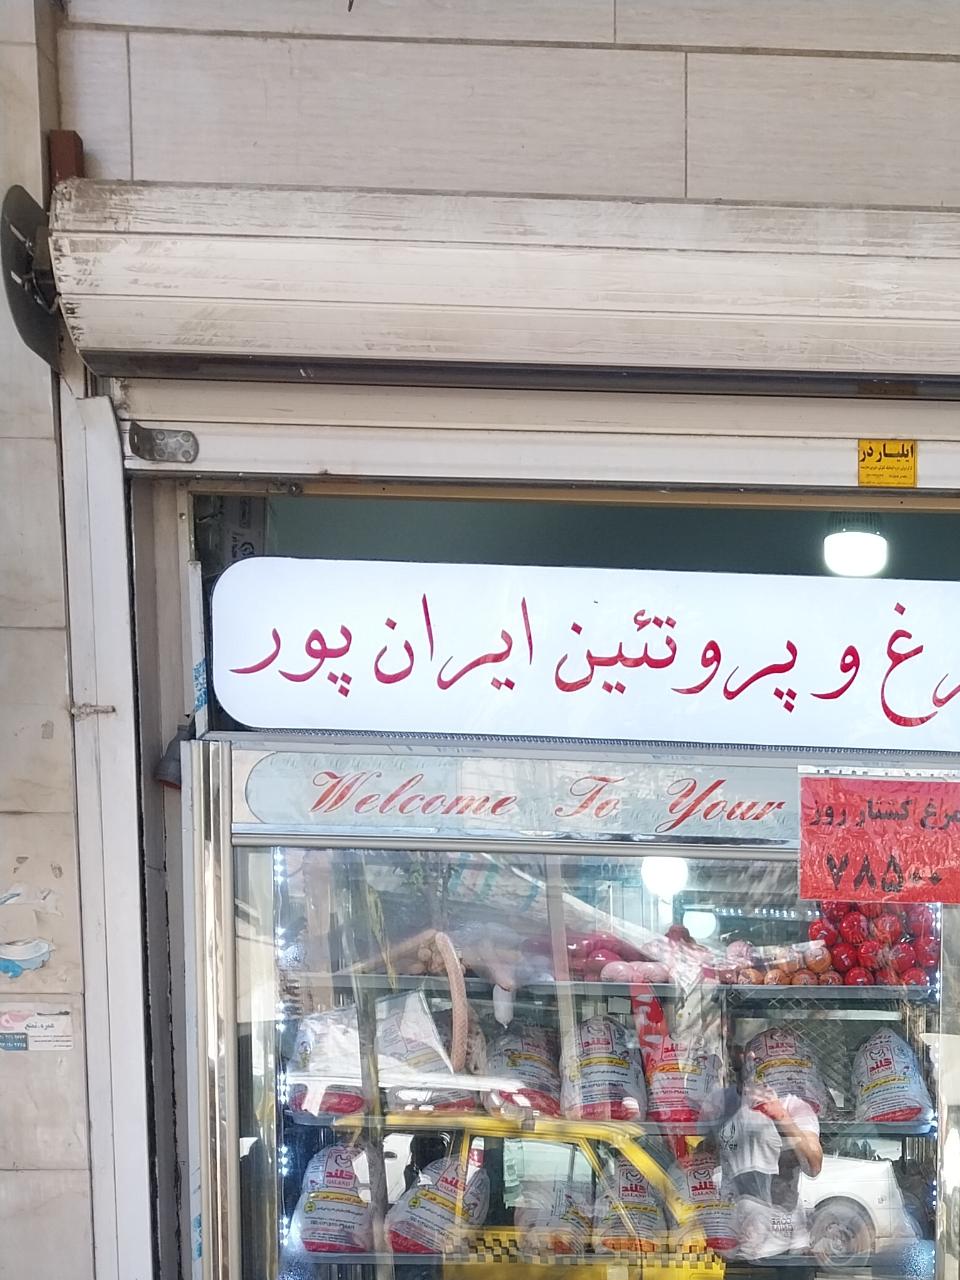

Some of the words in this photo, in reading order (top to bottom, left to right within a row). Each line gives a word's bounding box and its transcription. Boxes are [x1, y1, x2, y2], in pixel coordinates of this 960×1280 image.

[231, 621, 351, 696] پور
[373, 593, 534, 691] ایران
[555, 609, 798, 712] پروتئین
[811, 646, 861, 700] و
[312, 770, 519, 817] Welcome
[555, 774, 627, 819] To
[655, 777, 786, 834] Your
[809, 799, 847, 826] روز
[855, 799, 912, 828] کشتار
[827, 852, 943, 893] ۷۸۵۰۰
